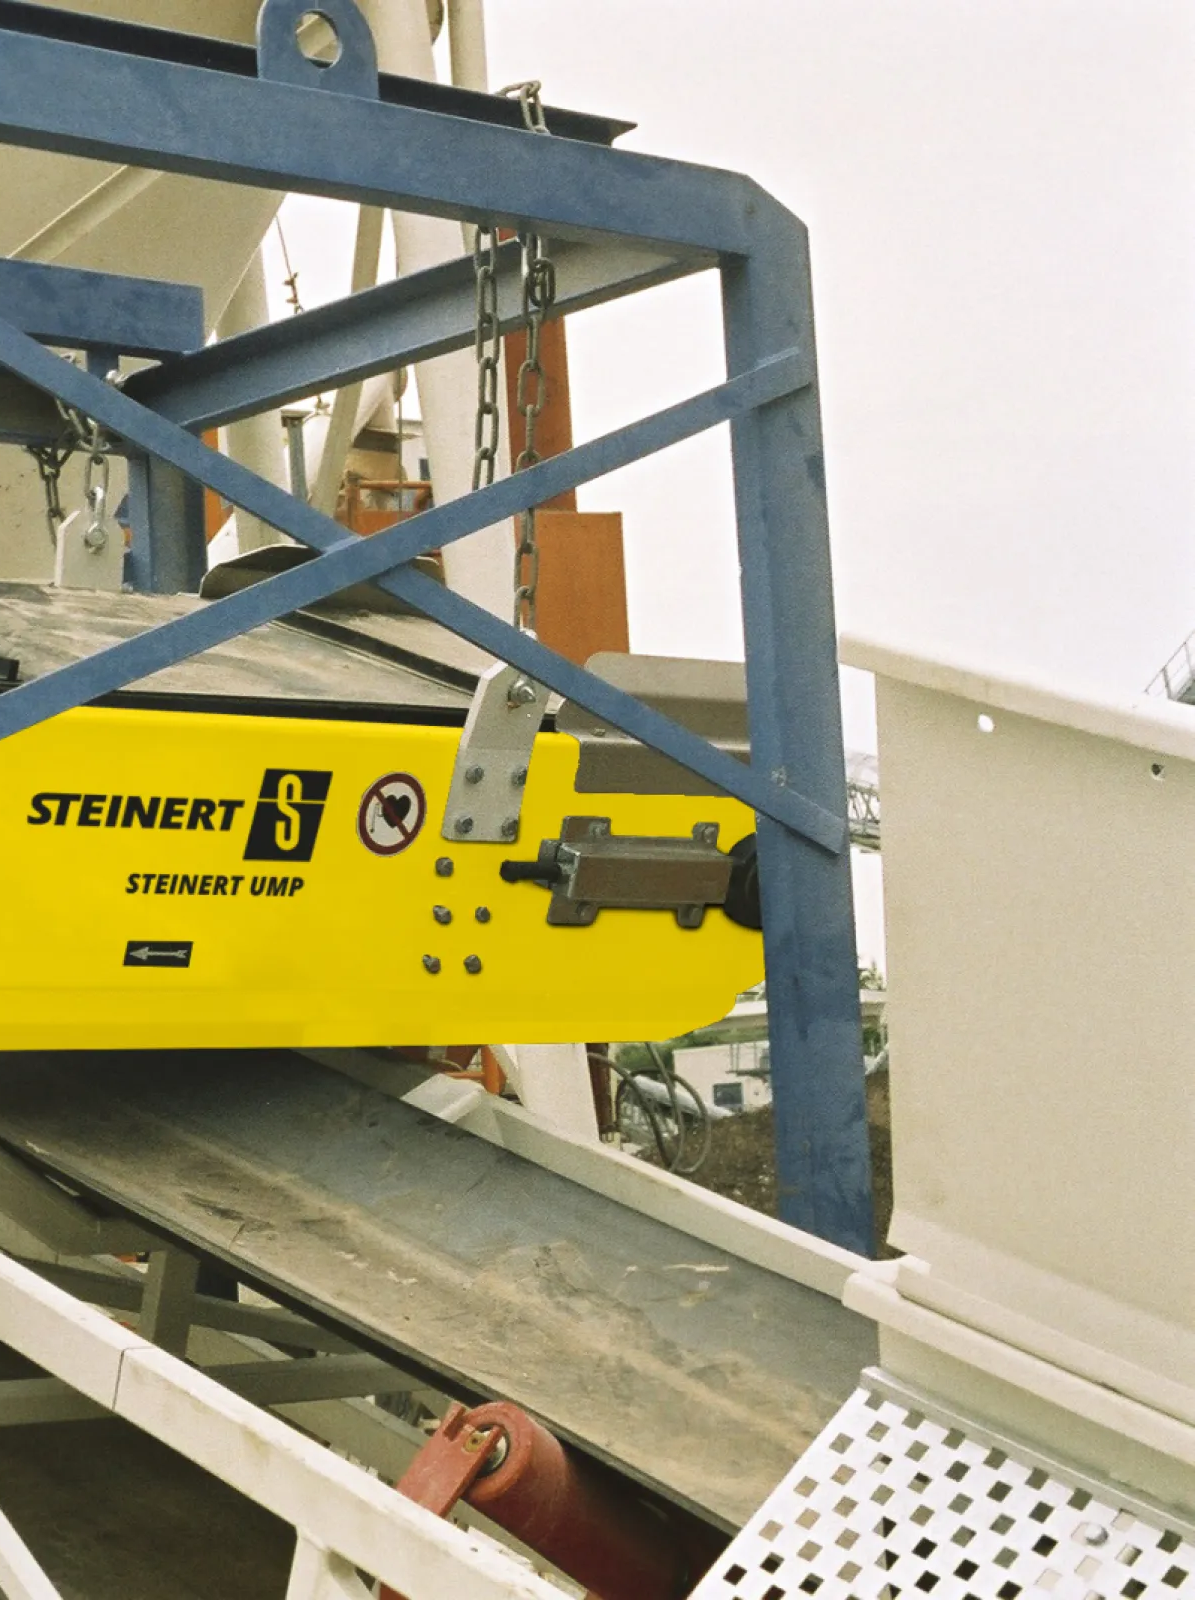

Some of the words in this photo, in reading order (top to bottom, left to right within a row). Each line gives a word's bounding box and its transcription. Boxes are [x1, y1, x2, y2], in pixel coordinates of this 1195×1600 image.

[26, 792, 245, 832] STEINERT
[125, 873, 244, 896] STEINERT
[249, 876, 305, 897] UMP
